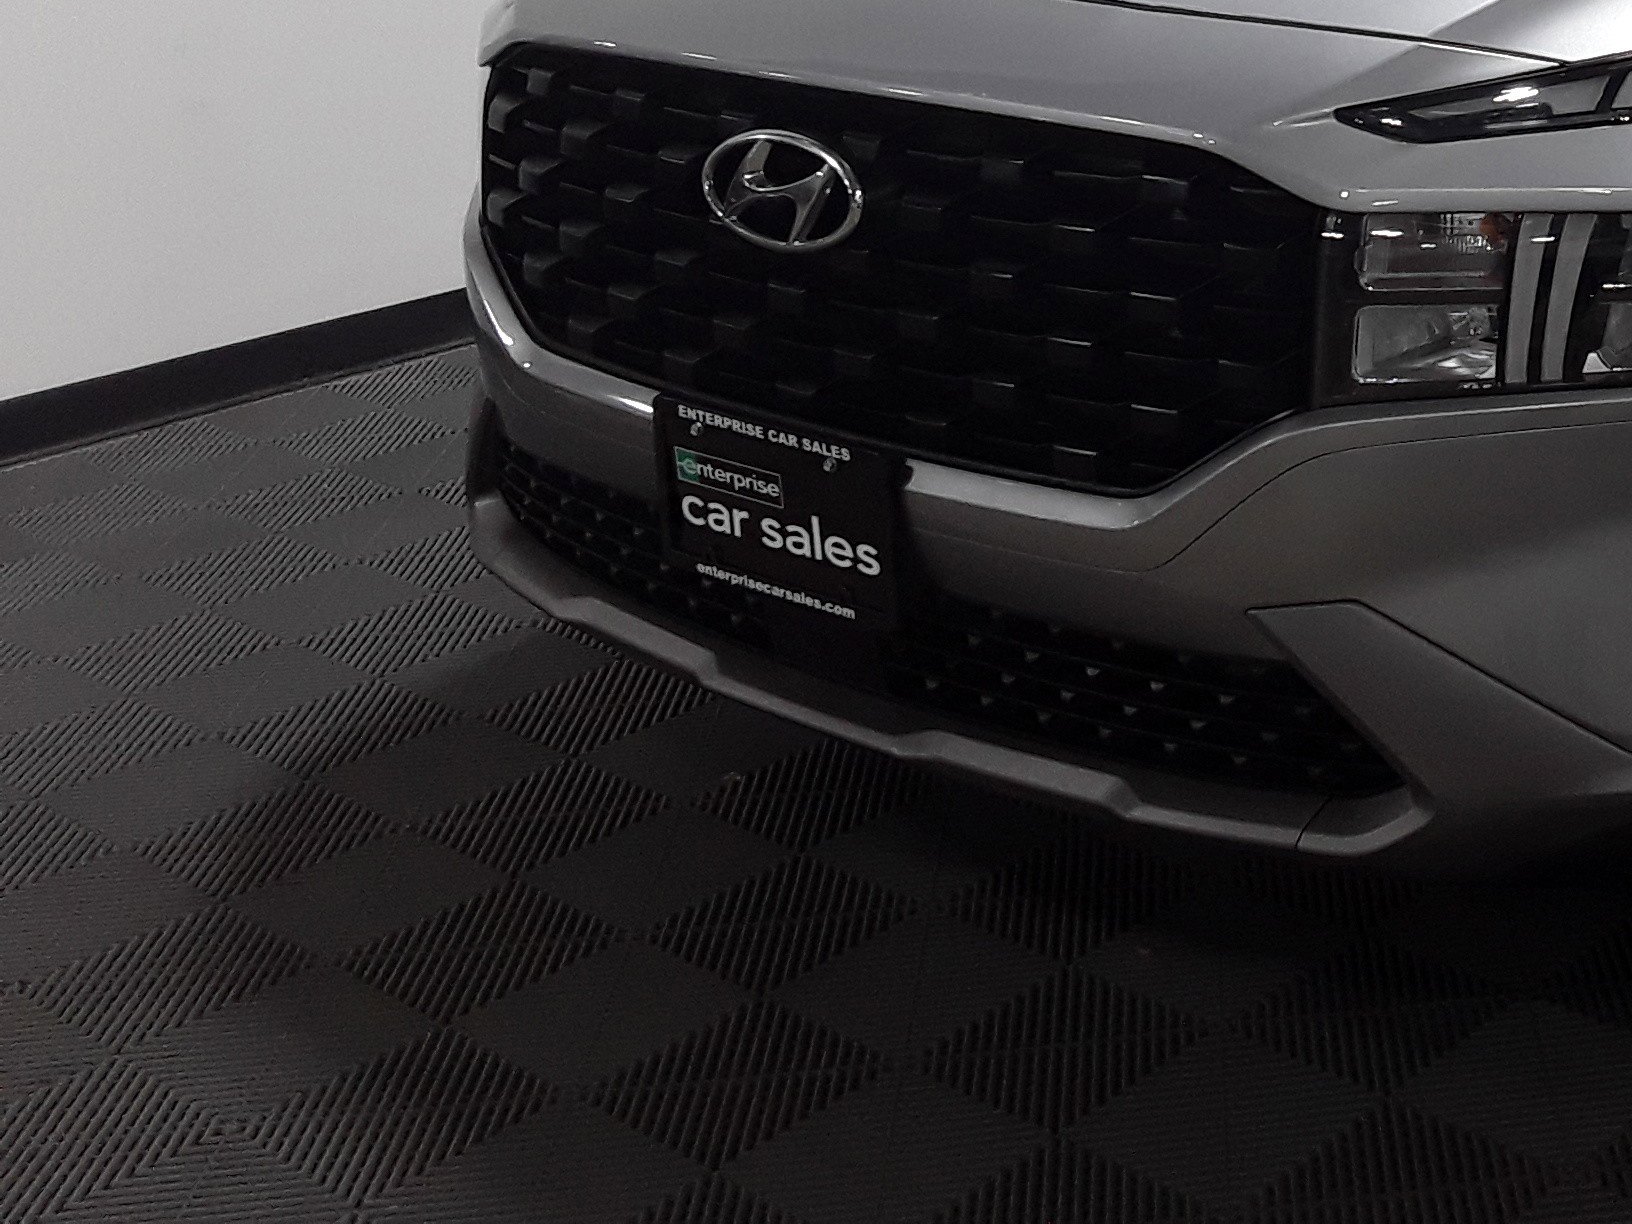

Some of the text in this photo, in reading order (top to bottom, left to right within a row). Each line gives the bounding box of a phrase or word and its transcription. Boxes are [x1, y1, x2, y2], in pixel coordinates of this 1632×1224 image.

[678, 405, 851, 462] ENTERPRISE CAR SALES
[679, 456, 780, 498] enterprise
[681, 495, 882, 576] car sales
[696, 562, 856, 620] enterprisecarsales.com
